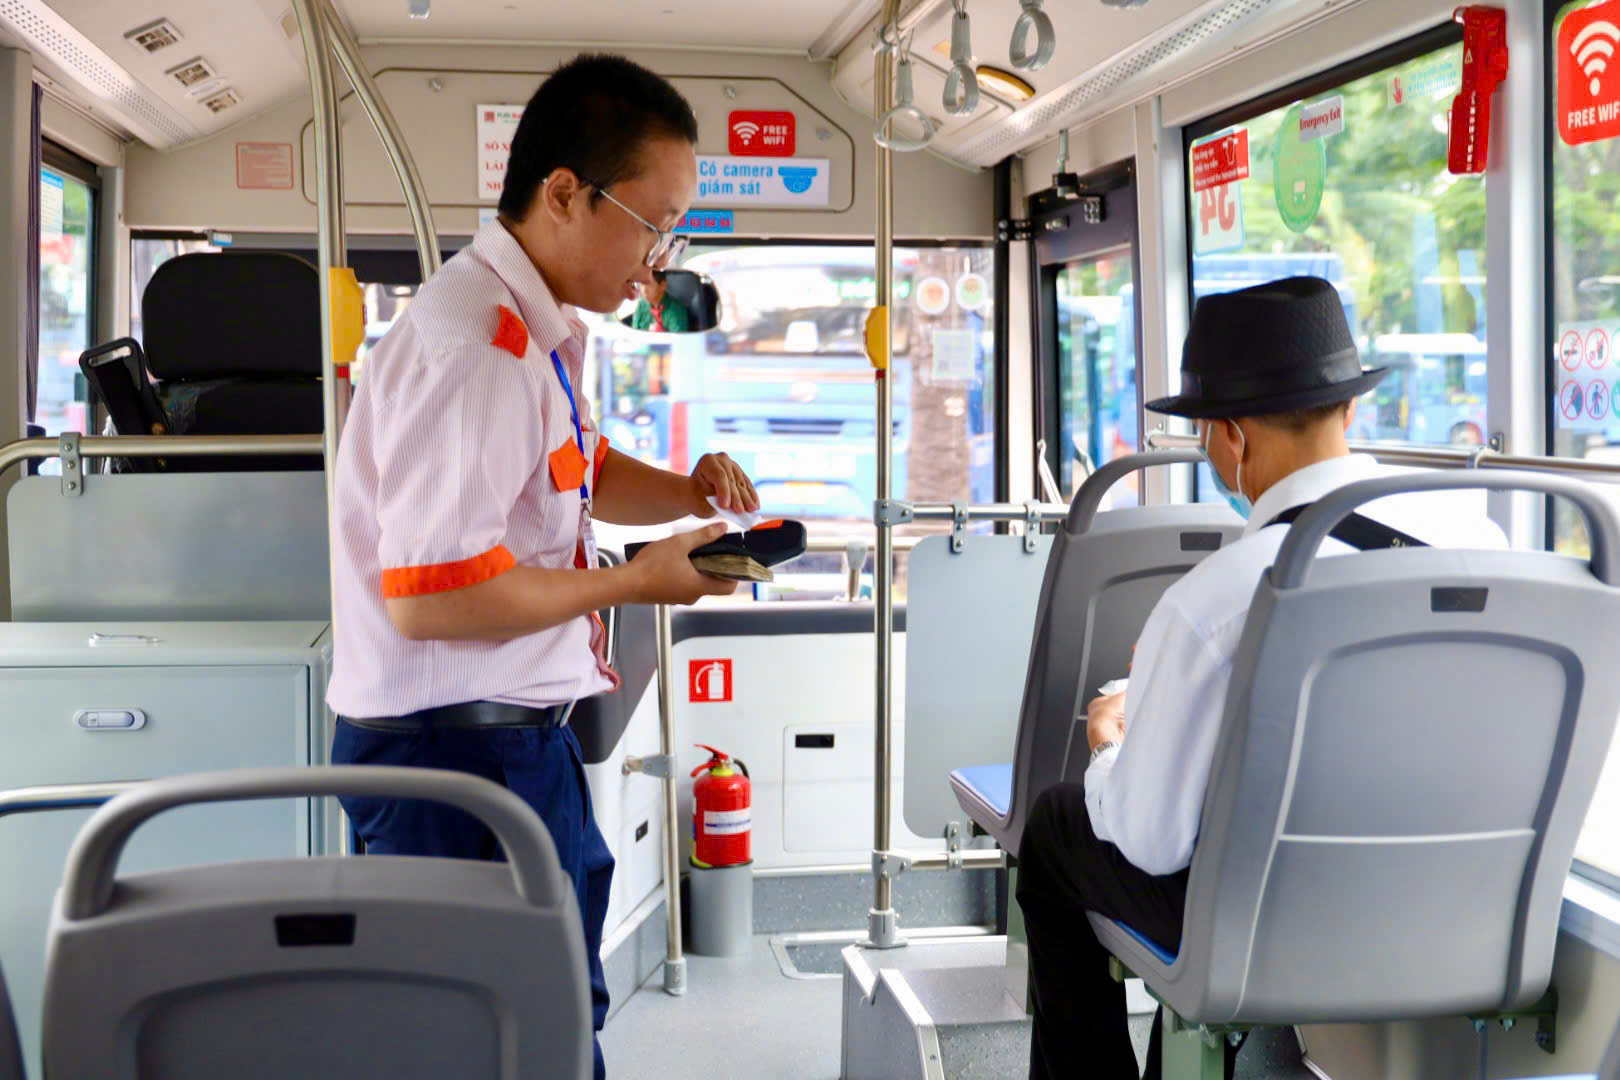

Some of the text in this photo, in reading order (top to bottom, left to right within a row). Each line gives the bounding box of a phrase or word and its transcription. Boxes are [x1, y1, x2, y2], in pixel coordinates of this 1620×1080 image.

[1300, 107, 1341, 131] Emergency Exit
[1568, 101, 1620, 129] FREE WIF
[763, 125, 788, 135] FREE
[763, 136, 785, 145] WIFI
[700, 160, 774, 177] Có camera
[487, 182, 505, 190] NH
[699, 179, 760, 196] giám sát
